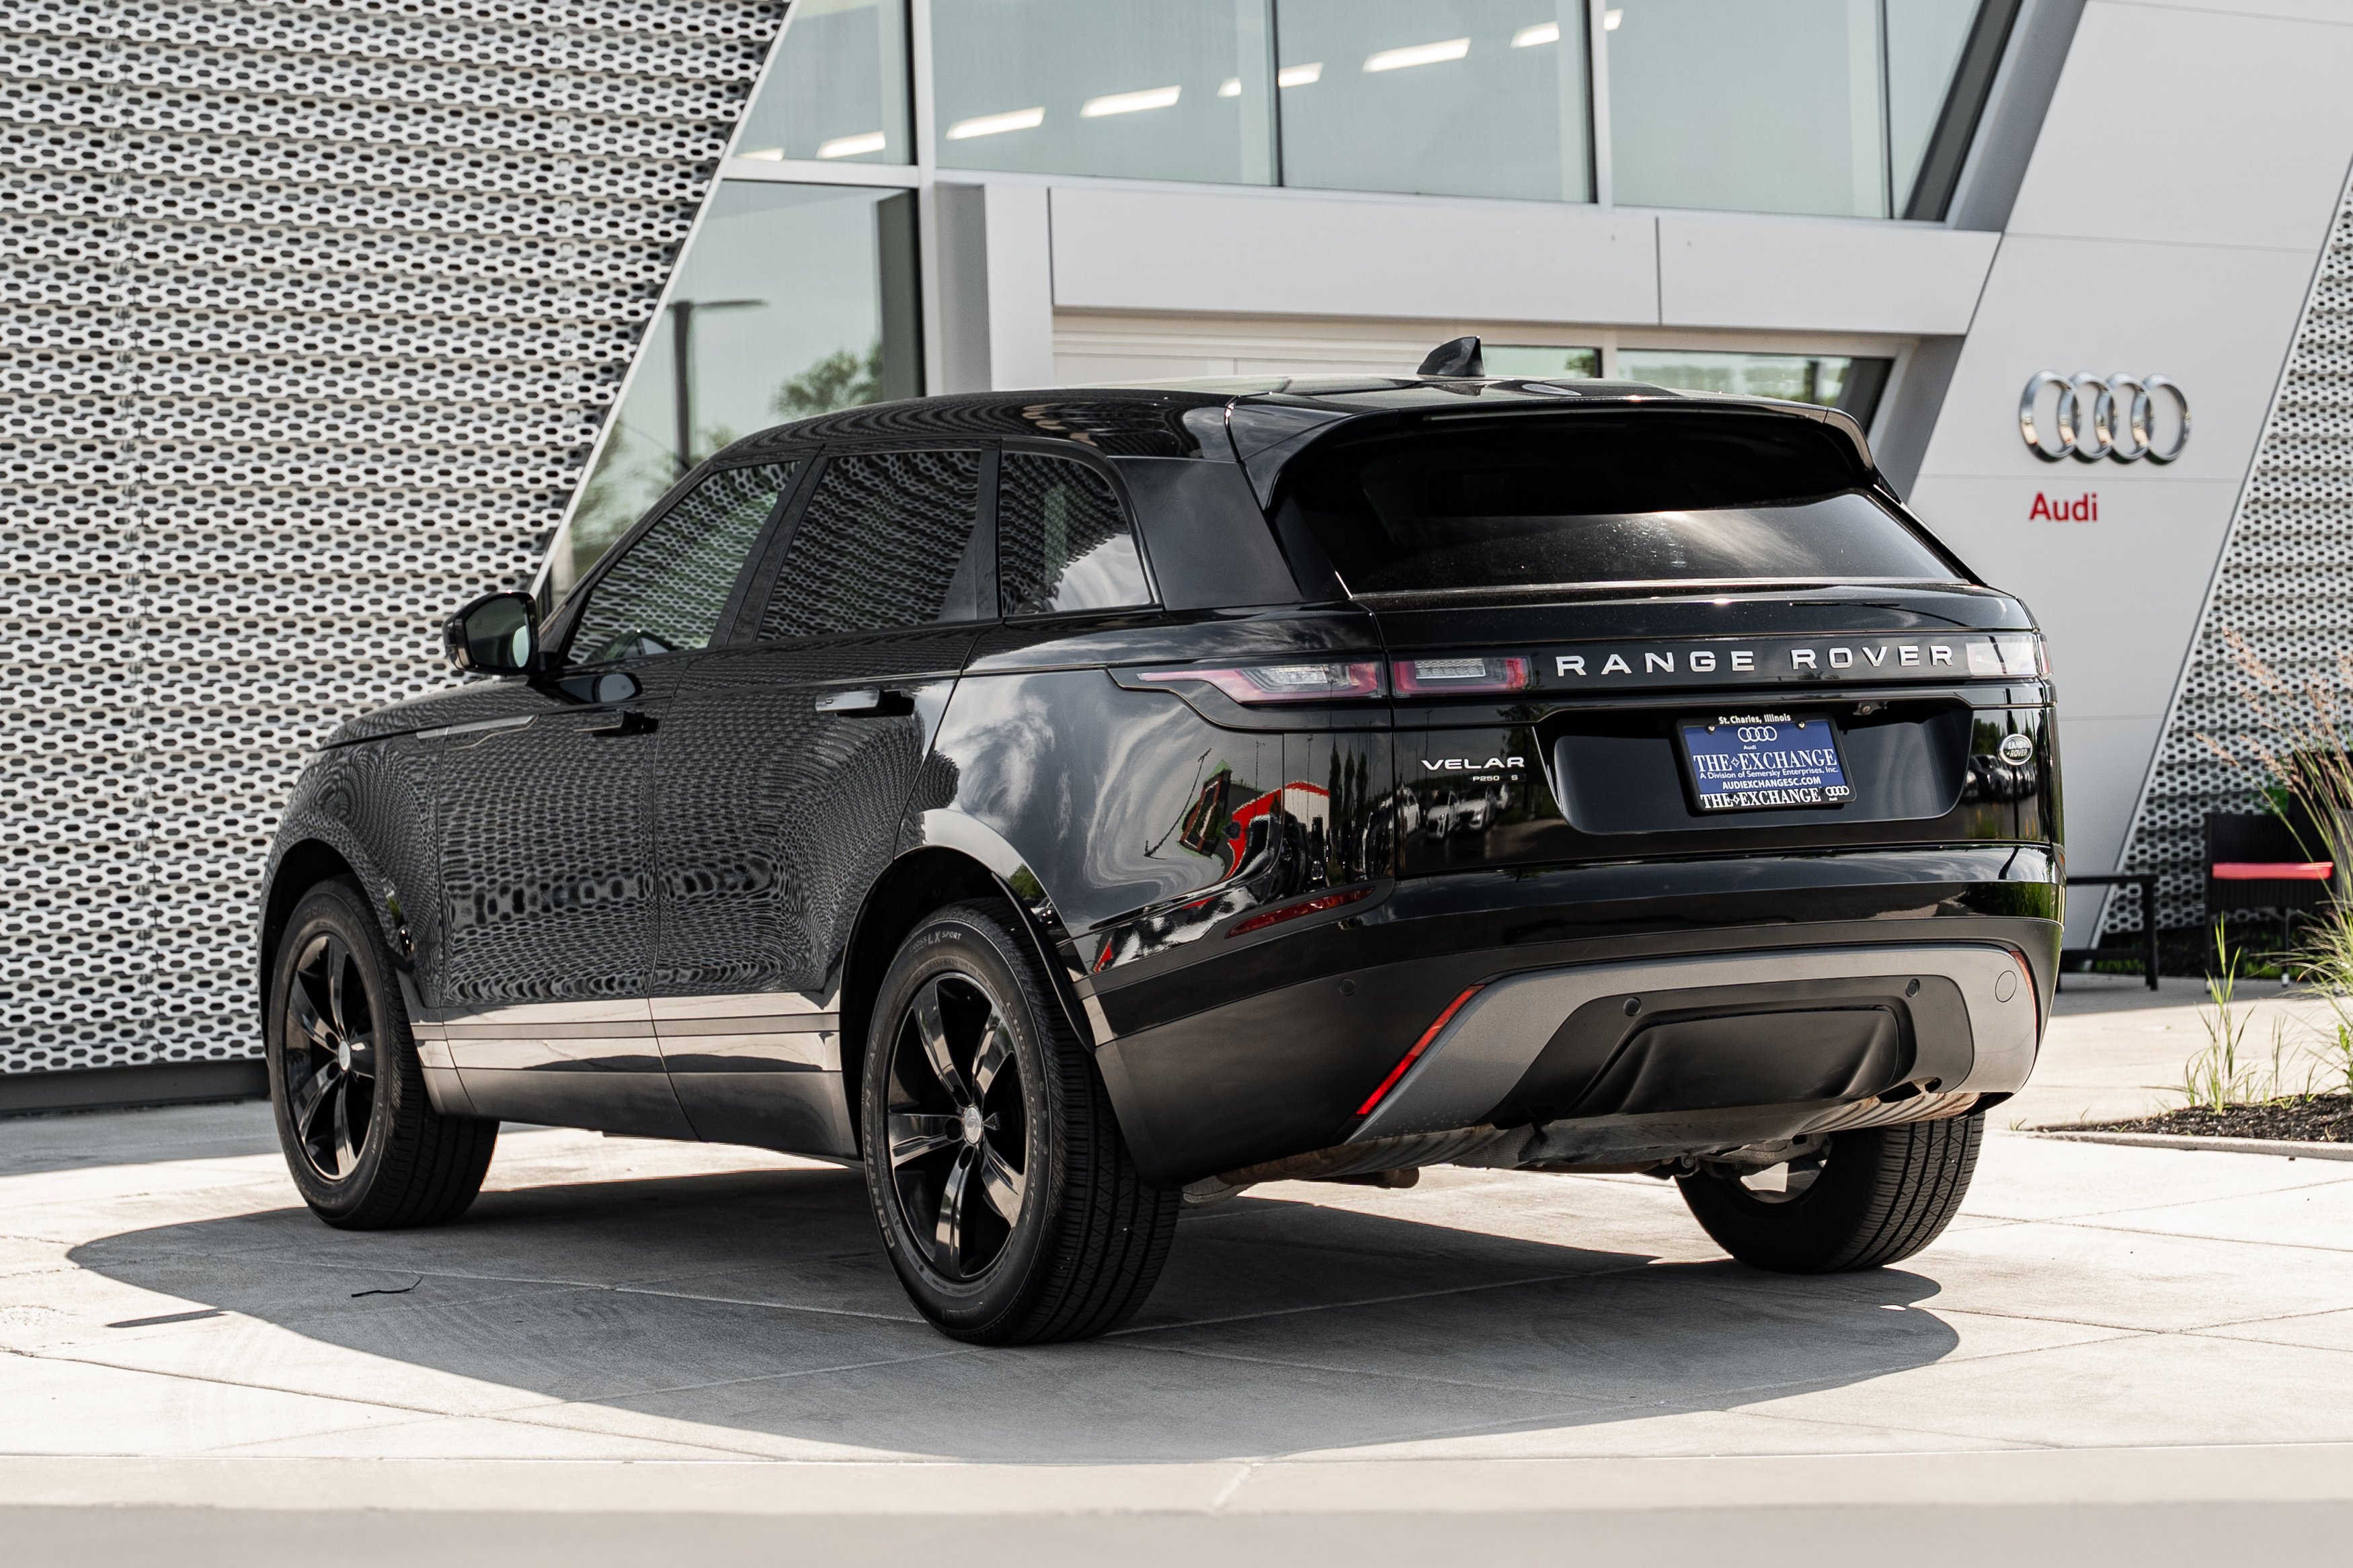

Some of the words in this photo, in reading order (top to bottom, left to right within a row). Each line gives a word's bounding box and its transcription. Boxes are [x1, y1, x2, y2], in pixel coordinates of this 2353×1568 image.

[2028, 491, 2098, 522] Audi
[1556, 651, 1755, 676] RANGE
[1790, 645, 1953, 670] ROVER
[1718, 716, 1730, 725] St.
[1730, 714, 1762, 724] Charles,
[1764, 713, 1791, 723] Illinois
[1421, 757, 1525, 770] VELAR
[1693, 754, 1732, 772] THE
[1737, 749, 1837, 770] EXCHANGE
[1708, 772, 1736, 780] Division
[1747, 769, 1781, 778] Semersky
[1782, 766, 1825, 776] Enterprises,
[1722, 776, 1821, 790] AUDIEXCHANGESC.COM
[1700, 793, 1734, 809] THE
[1737, 788, 1821, 807] EXCHANGE
[928, 930, 941, 946] LX
[941, 930, 962, 941] SPORT
